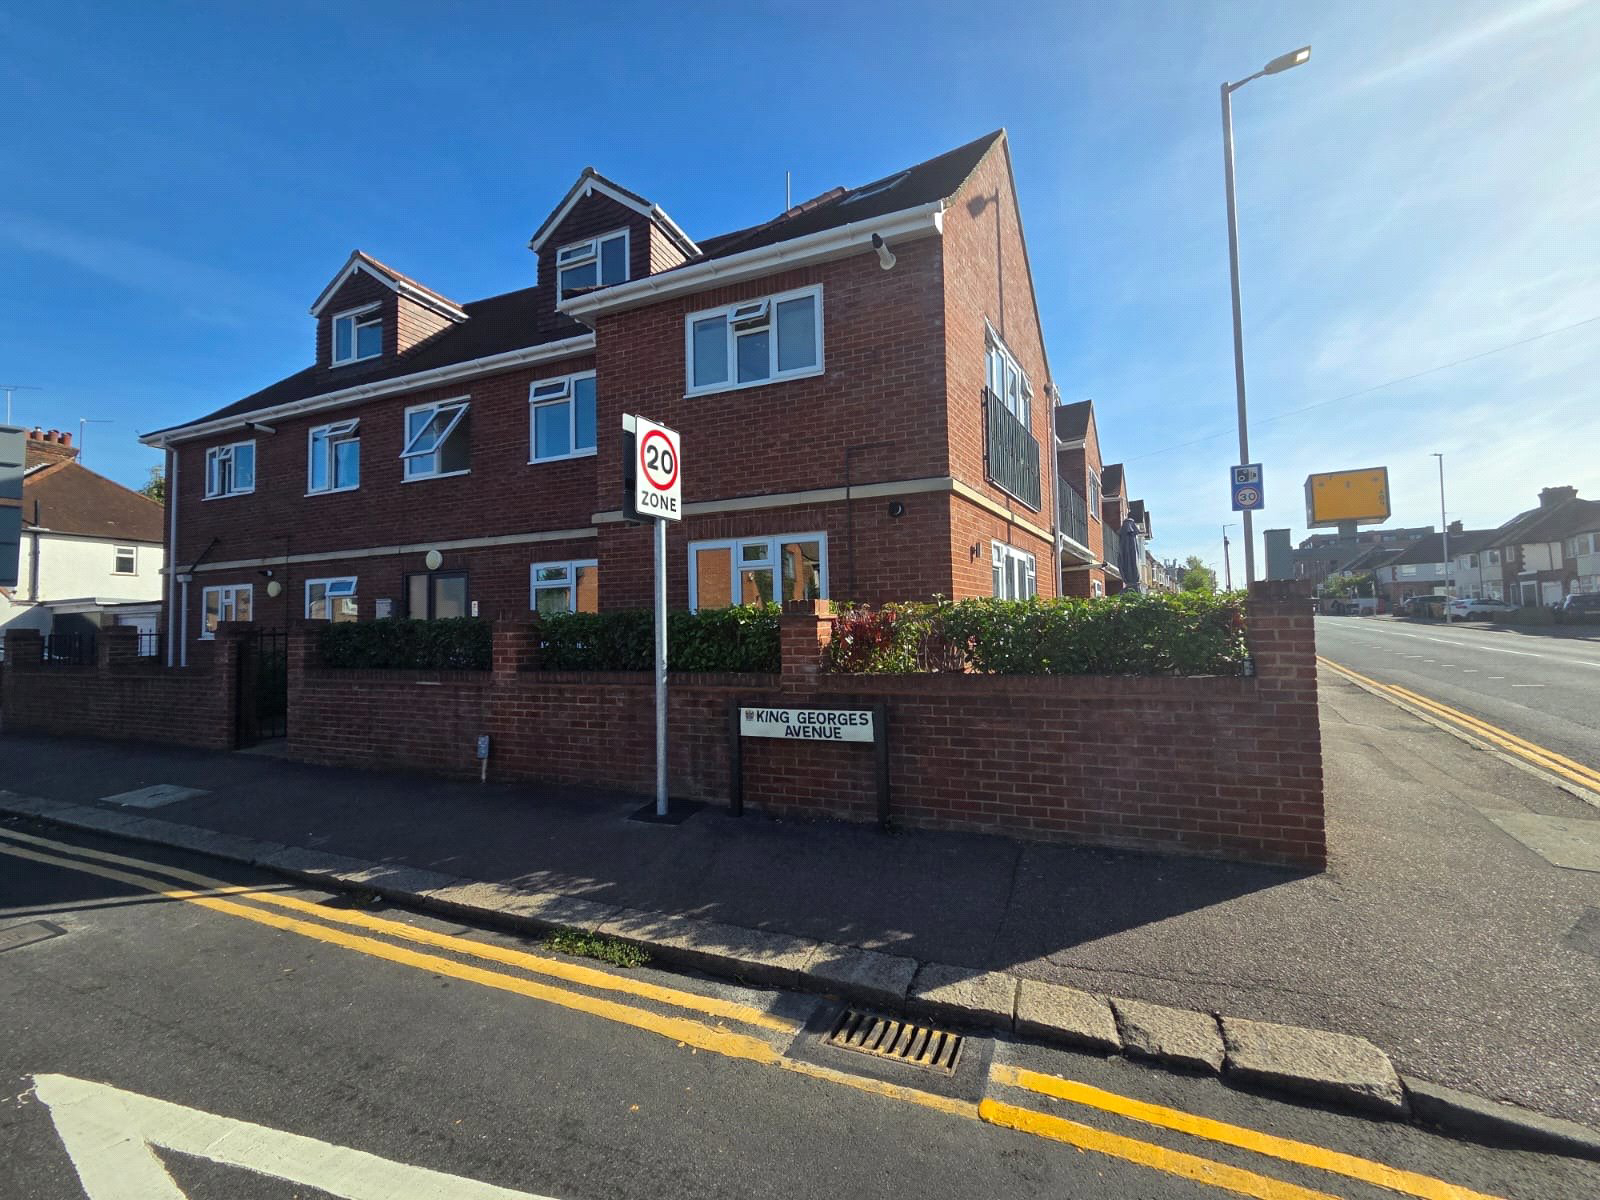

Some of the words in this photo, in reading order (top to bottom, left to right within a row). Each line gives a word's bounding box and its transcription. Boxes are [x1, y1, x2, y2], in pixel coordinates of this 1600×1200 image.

[647, 445, 673, 474] 20
[641, 490, 677, 512] ZONE
[1239, 492, 1257, 502] 30
[756, 710, 789, 723] KING
[797, 712, 869, 725] GEORGES
[785, 725, 843, 739] AVENUE
